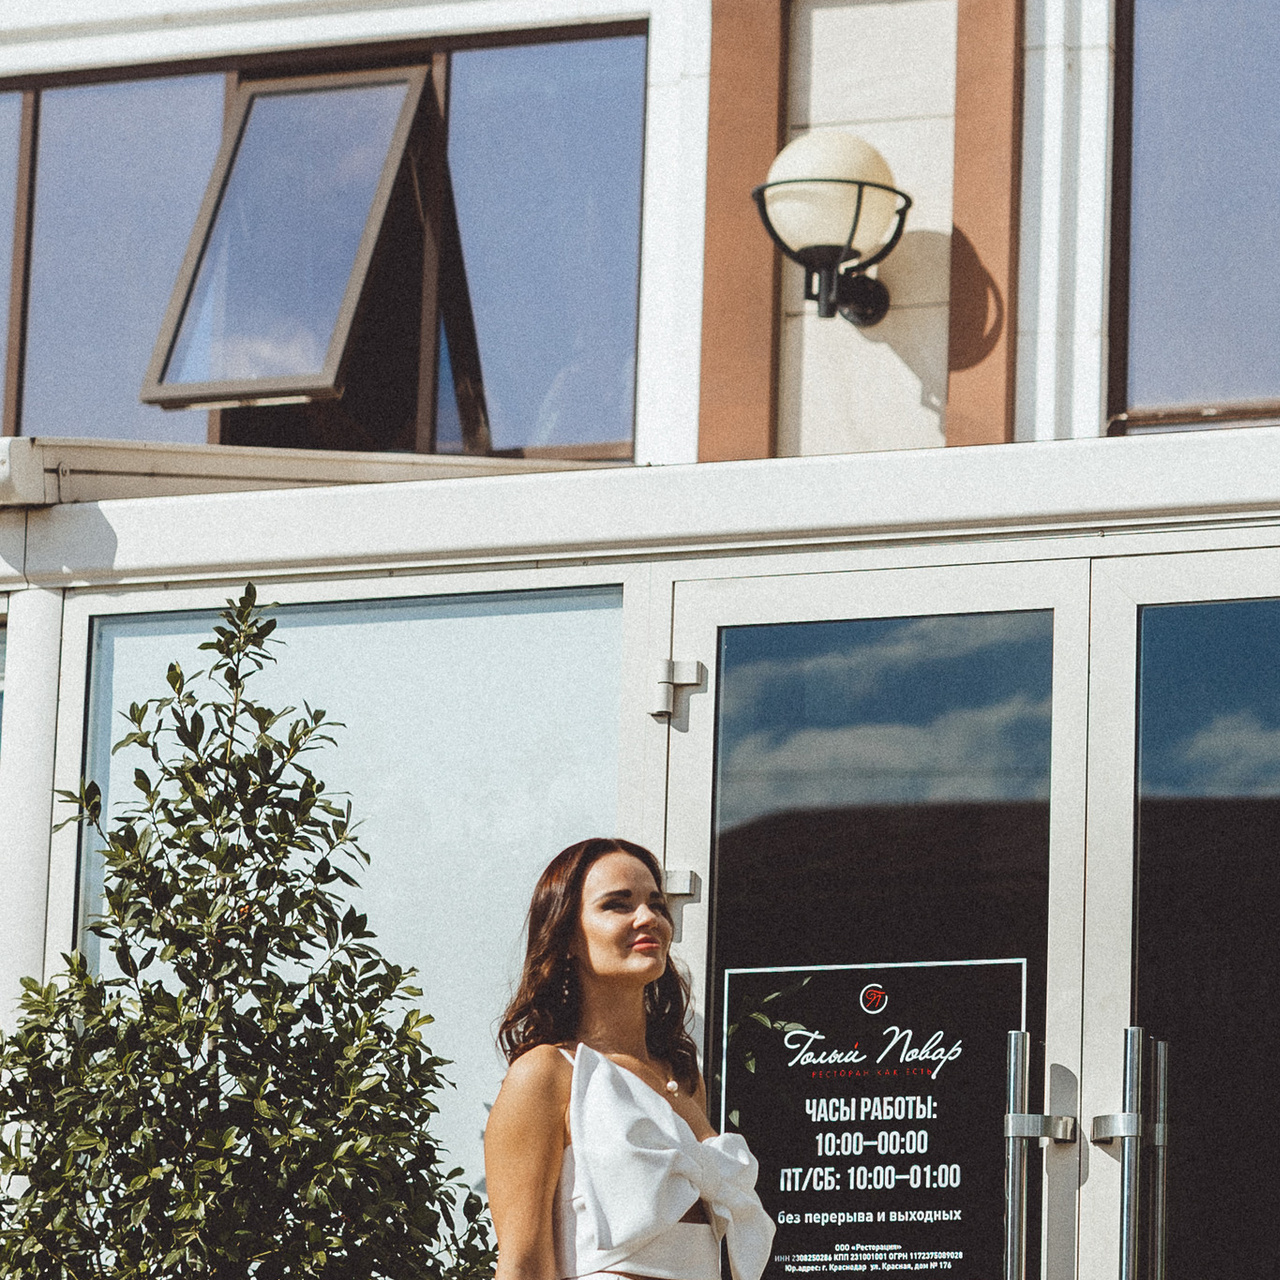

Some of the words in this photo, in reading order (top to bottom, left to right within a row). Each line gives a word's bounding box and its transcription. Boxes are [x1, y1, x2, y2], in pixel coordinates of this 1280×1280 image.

[784, 1030, 868, 1068] Голый
[876, 1026, 963, 1080] Повар
[811, 1069, 869, 1079] РЕСТОРАН
[877, 1068, 899, 1077] КАК
[906, 1067, 933, 1076] ЕСТЬ
[805, 1097, 857, 1122] ЧАСЫ
[860, 1095, 938, 1121] РАБОТЫ:
[779, 1166, 841, 1192] ПТ/СБ:
[777, 1210, 801, 1225] без
[804, 1210, 875, 1227] перерыва
[876, 1210, 887, 1223] и
[889, 1209, 963, 1224] выходных
[834, 1243, 850, 1252] ООО
[833, 1253, 850, 1262] КПП
[888, 1252, 908, 1261] ОГРН
[939, 1261, 953, 1270] 176
